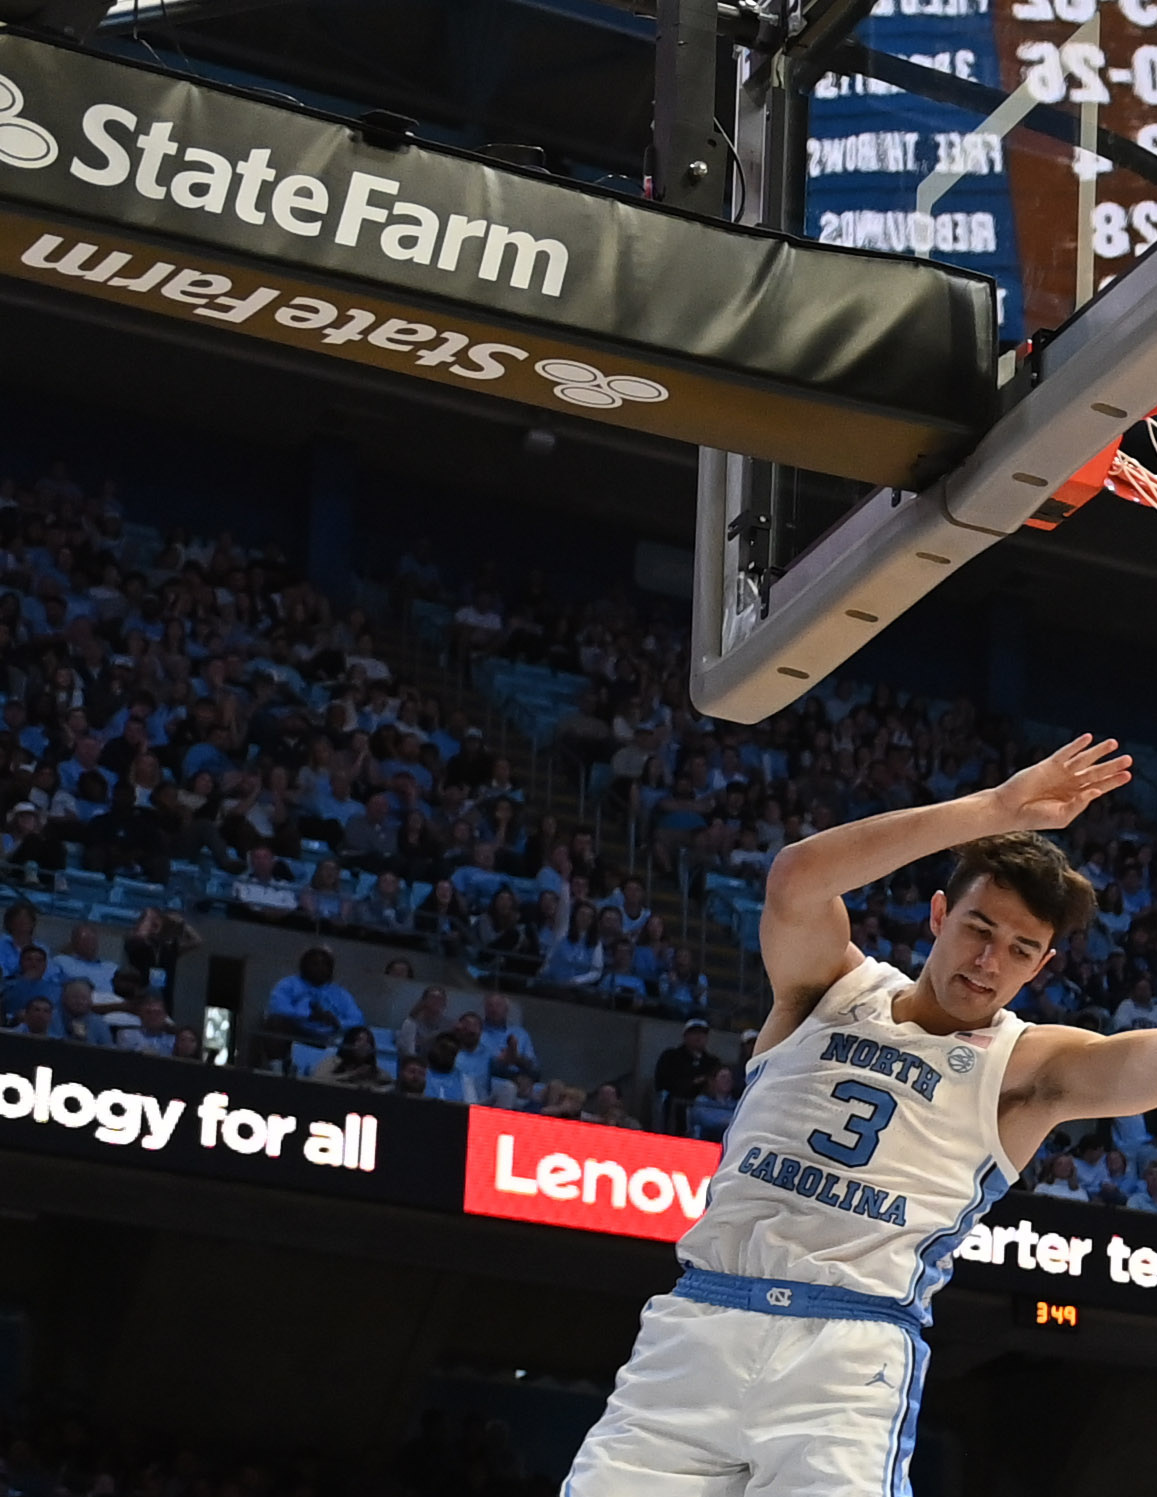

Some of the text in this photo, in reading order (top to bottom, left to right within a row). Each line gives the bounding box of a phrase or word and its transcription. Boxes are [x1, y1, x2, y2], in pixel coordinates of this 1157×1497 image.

[820, 1032, 942, 1102] NORTH
[0, 1066, 378, 1172] ology for all
[807, 1079, 899, 1168] 3
[738, 1147, 908, 1227] CAROLINA
[953, 1220, 1093, 1276] arter
